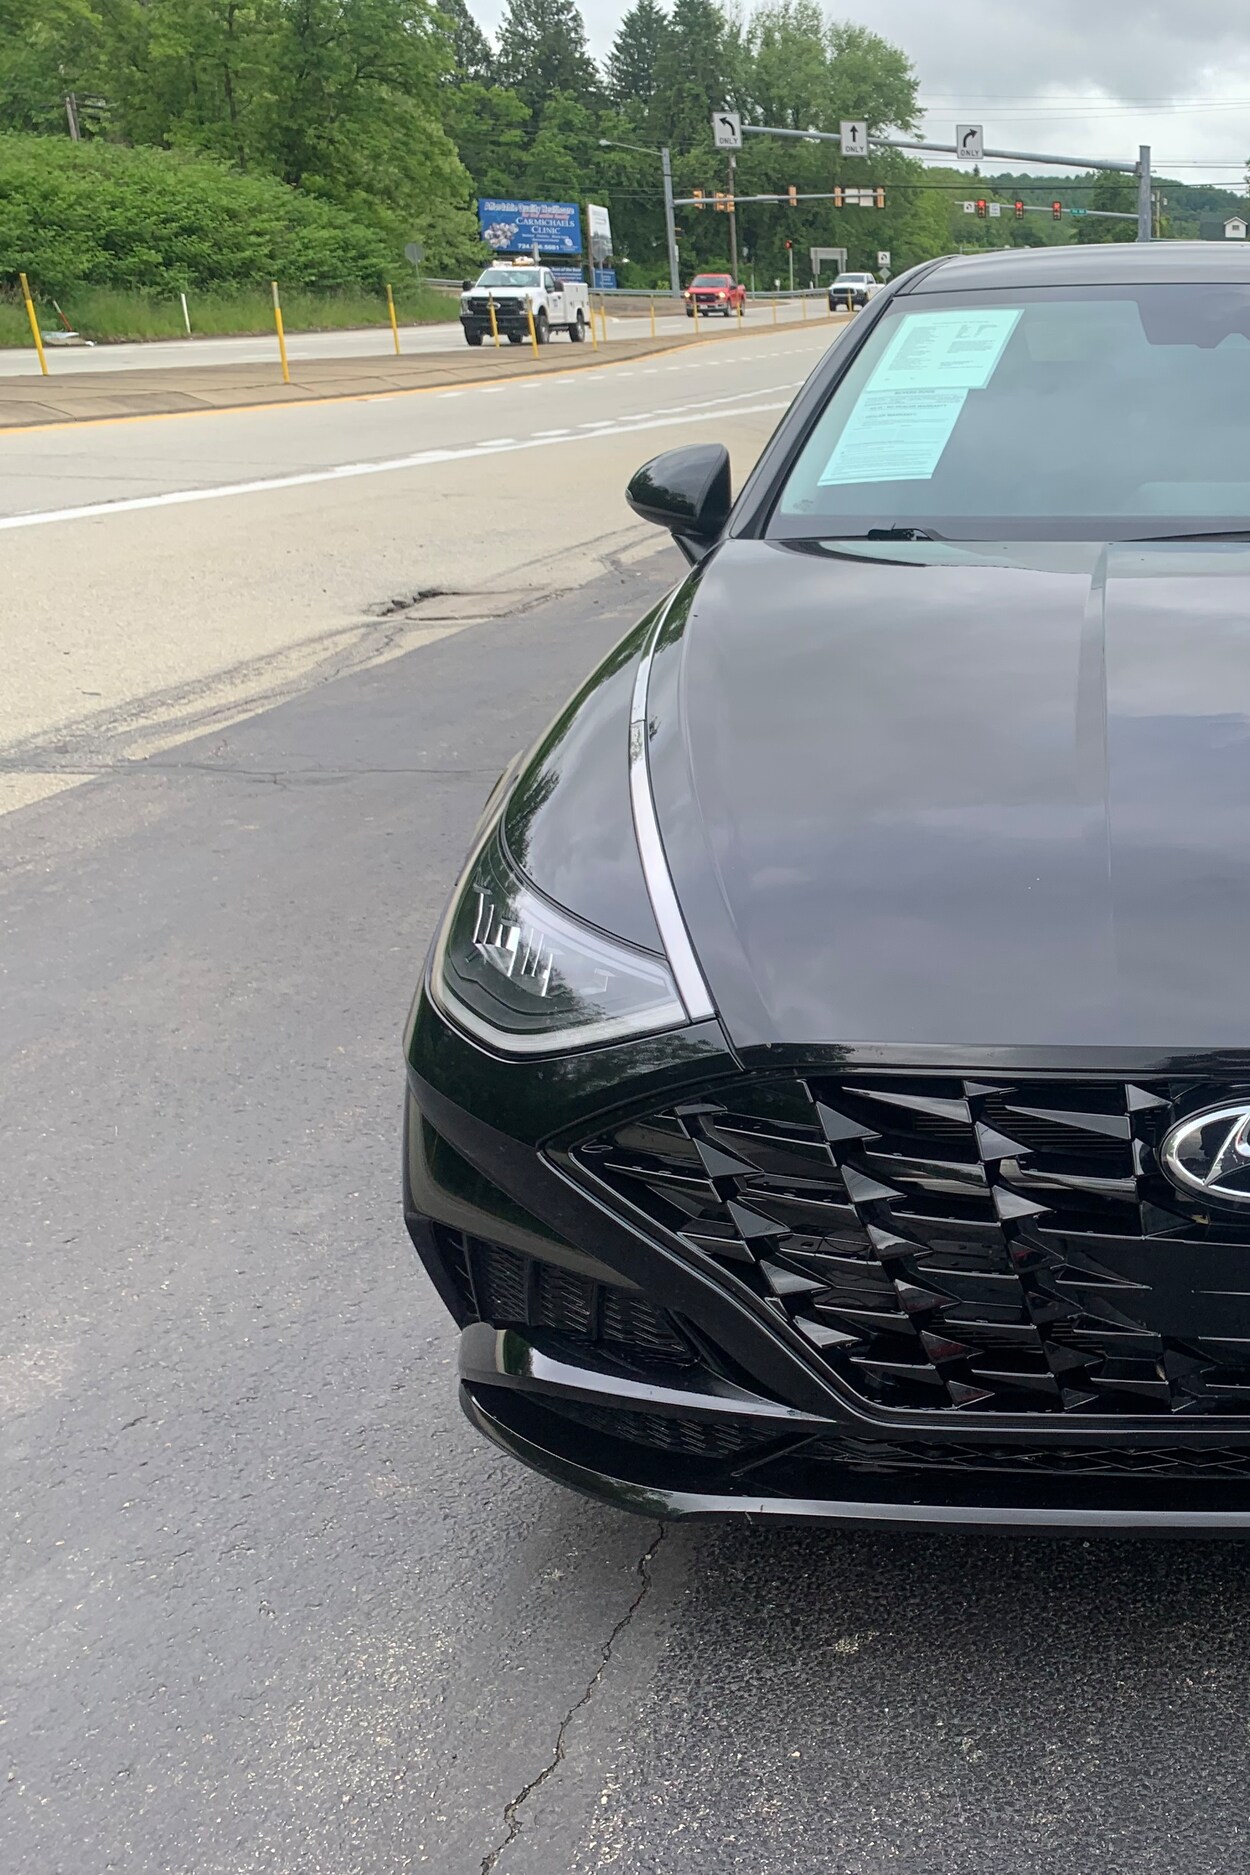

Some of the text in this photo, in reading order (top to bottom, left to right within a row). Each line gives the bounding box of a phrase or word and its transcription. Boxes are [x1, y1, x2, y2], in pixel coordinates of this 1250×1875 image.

[719, 137, 738, 145] ONLY
[960, 149, 980, 157] ONLY
[516, 217, 575, 227] CARMICHAELS
[531, 226, 561, 234] CLINIC
